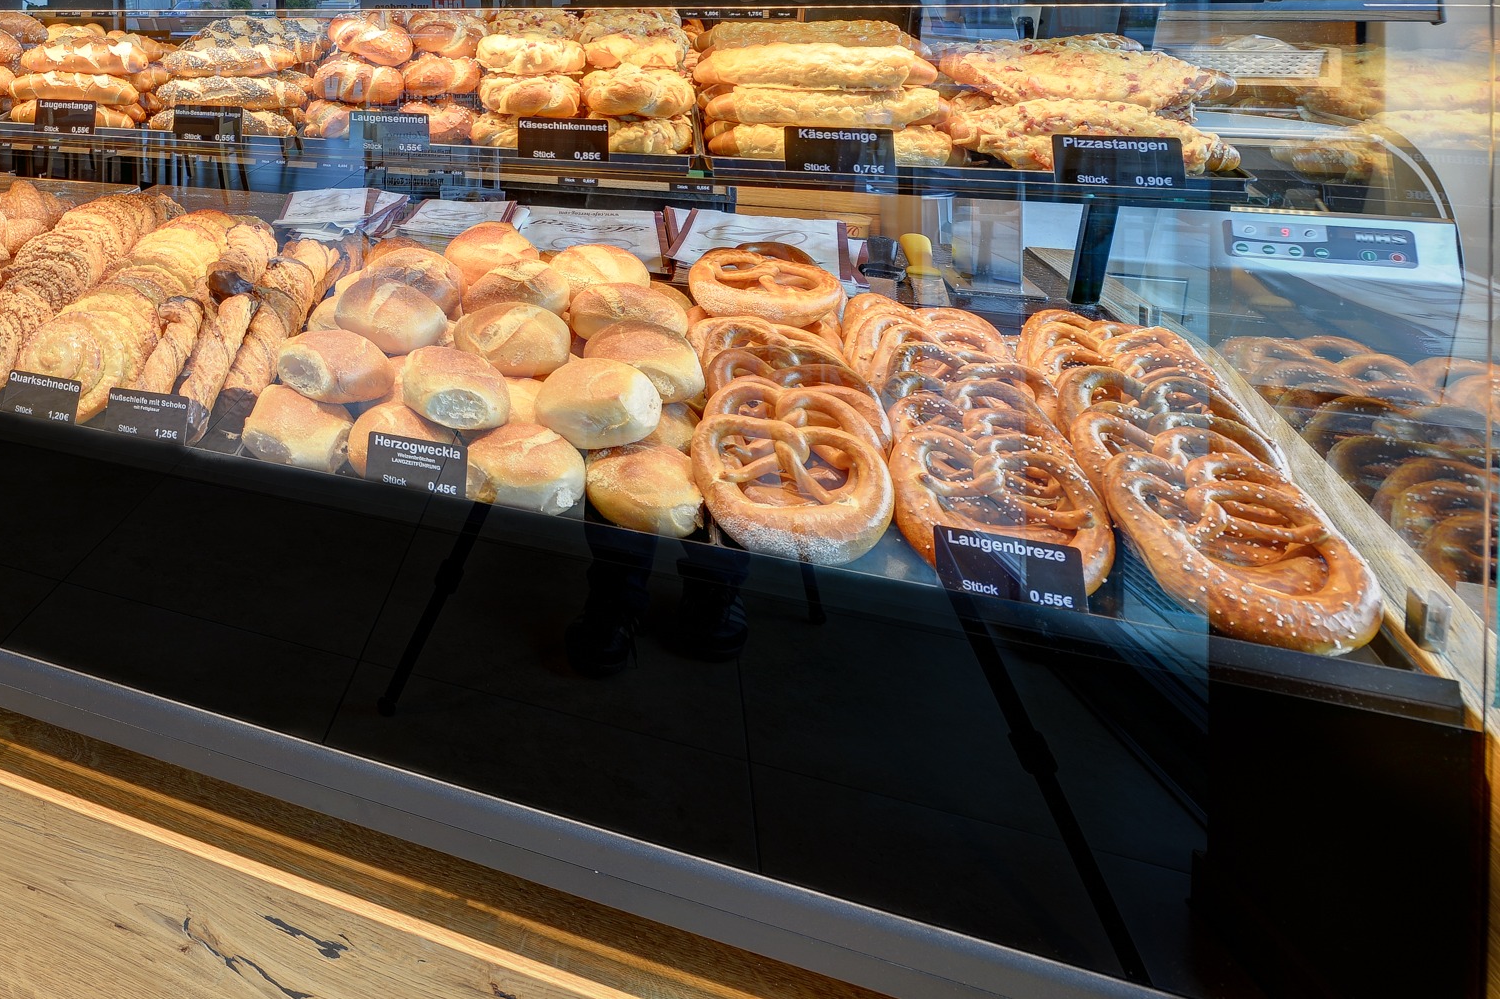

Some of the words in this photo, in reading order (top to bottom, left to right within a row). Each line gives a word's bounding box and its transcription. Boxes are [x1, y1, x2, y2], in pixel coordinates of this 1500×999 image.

[39, 101, 93, 112] Laugenstange
[351, 113, 427, 124] Laugensemmel
[43, 125, 59, 133] Stück
[519, 120, 607, 132] Käseschinkennest
[215, 134, 235, 142] 0,55€
[798, 128, 877, 143] Käsestange
[362, 142, 382, 150] Stück
[399, 144, 422, 152] 0,55€
[1062, 137, 1168, 152] Pizzastangen
[532, 150, 556, 159] Stück
[574, 151, 601, 161] 0,85€
[804, 162, 831, 172] Stück
[853, 164, 885, 175] 0,75€
[1077, 174, 1108, 184] Stück
[1135, 176, 1173, 187] 0,90€
[1355, 232, 1408, 245] MHS
[10, 371, 80, 393] Quarkschnecke
[109, 393, 148, 405] Nußschleife
[161, 400, 187, 410] Schoko
[15, 404, 33, 415] Stück
[48, 410, 70, 422] 1,20€
[117, 424, 138, 434] Stück
[154, 428, 178, 439] 1,25€
[374, 434, 461, 460] Herzogweckla
[391, 457, 441, 471] LANGZEITFÜHRUNG
[382, 474, 407, 487] Stück
[427, 481, 457, 495] 0,45€
[947, 530, 1066, 562] Laugenbreze
[962, 579, 999, 596] Stück
[1029, 590, 1074, 609] 0,55€
